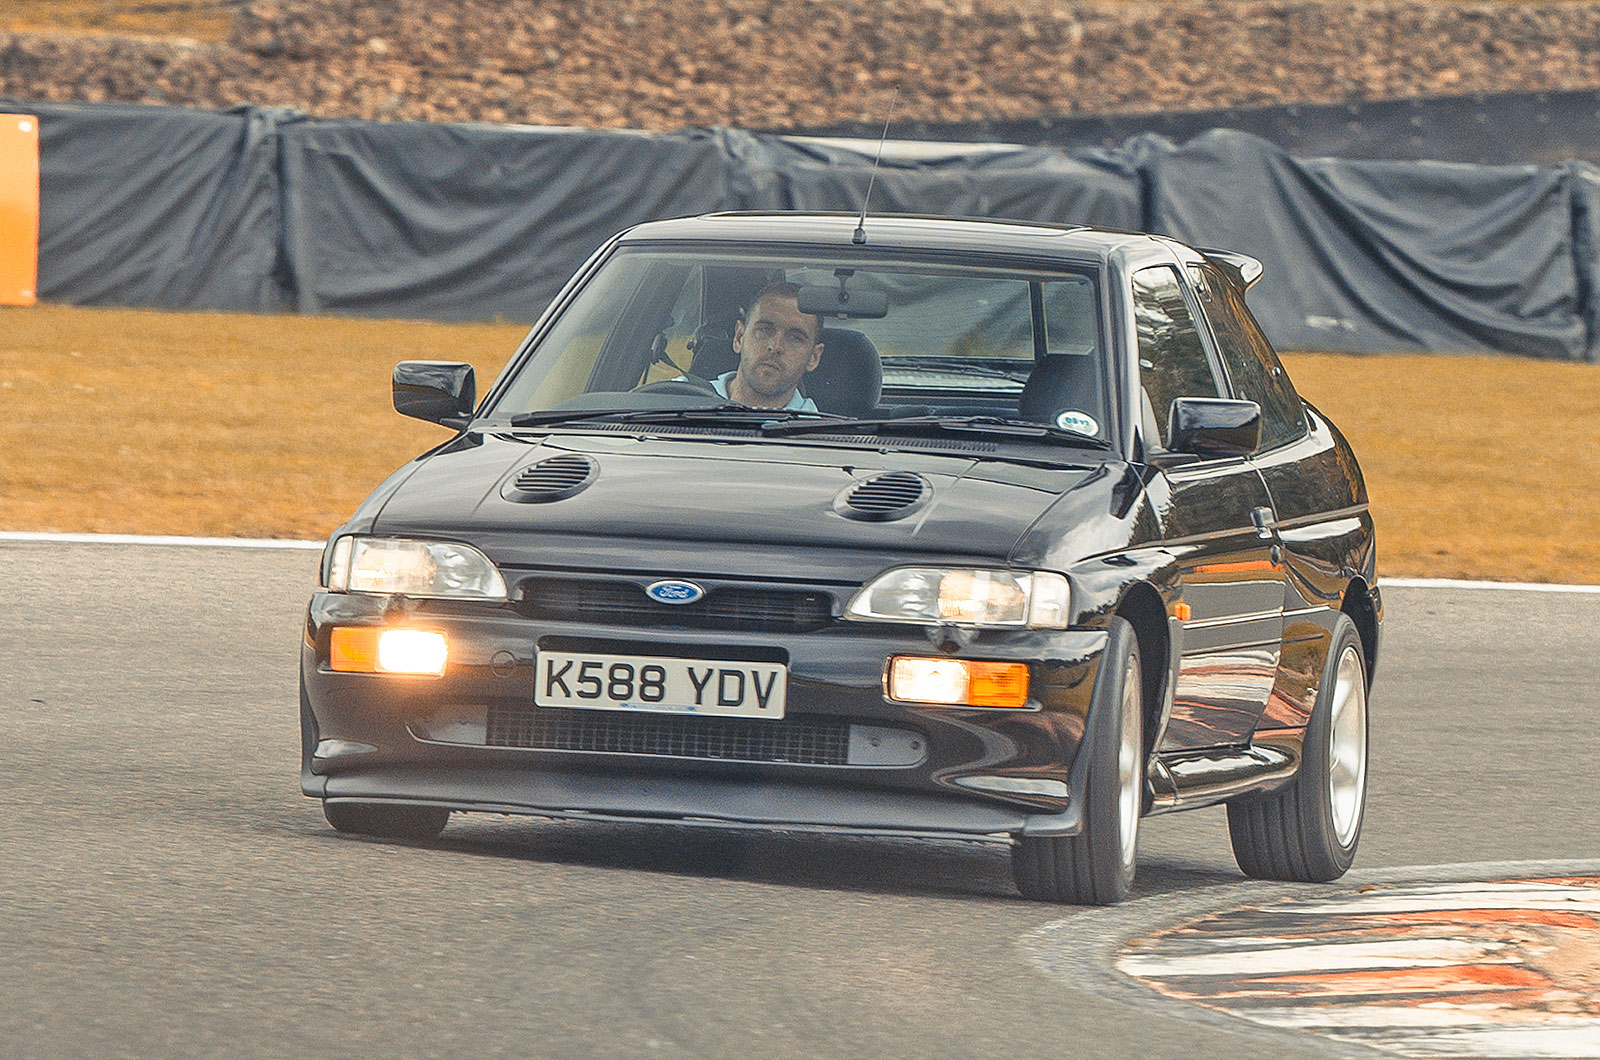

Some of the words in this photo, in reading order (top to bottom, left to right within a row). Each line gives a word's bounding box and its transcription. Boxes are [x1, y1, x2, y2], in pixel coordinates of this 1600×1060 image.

[658, 584, 690, 598] Ford
[546, 660, 666, 702] K588
[687, 666, 777, 709] YDV
